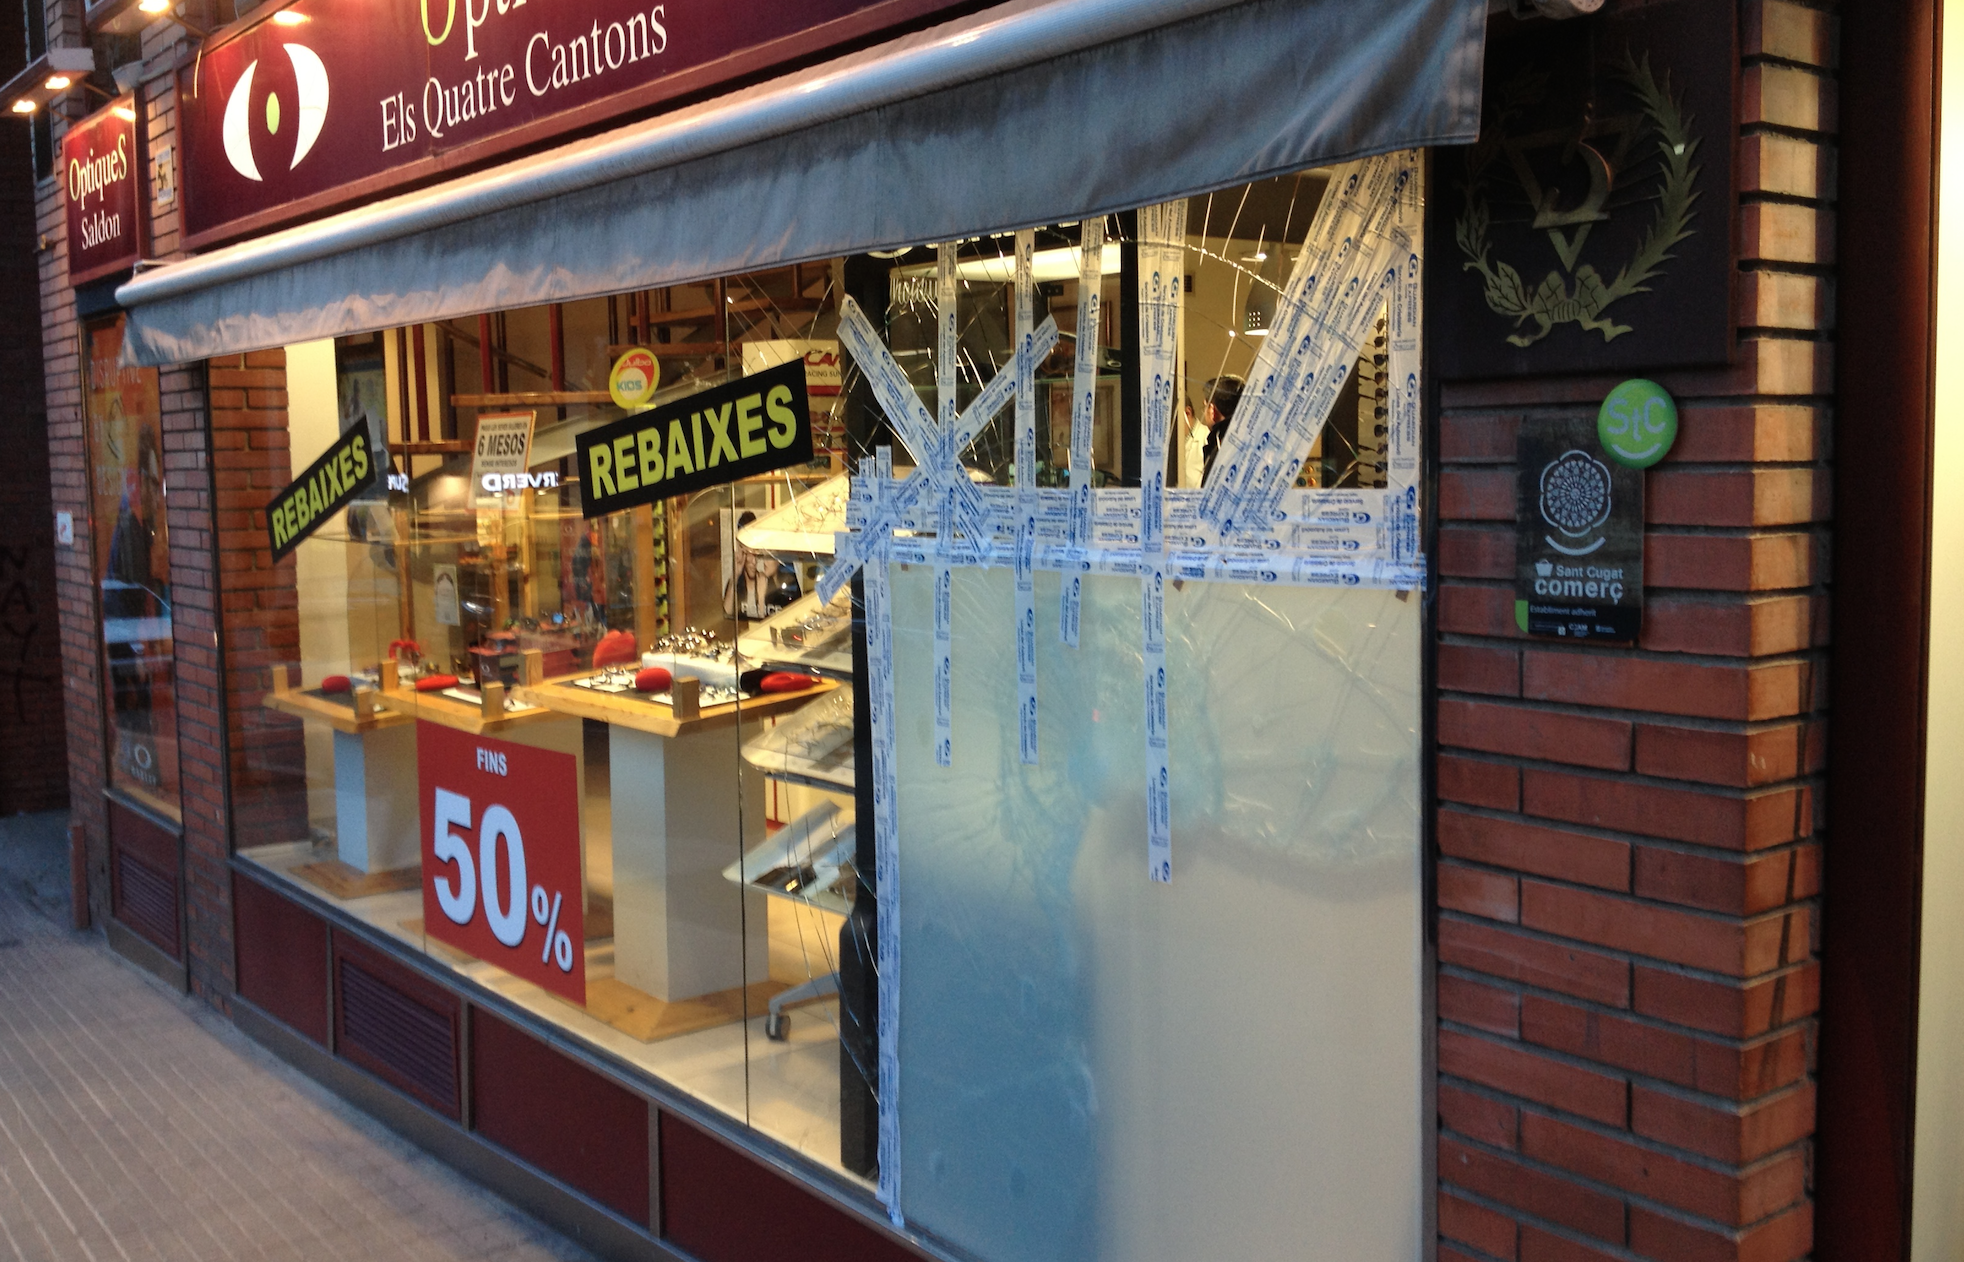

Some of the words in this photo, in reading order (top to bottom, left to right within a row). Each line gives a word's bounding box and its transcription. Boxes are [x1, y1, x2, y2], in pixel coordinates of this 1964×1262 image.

[380, 91, 416, 152] Els
[423, 64, 516, 138] Quatre
[525, 5, 668, 97] Cantons
[81, 210, 121, 250] Saldon
[1606, 396, 1667, 442] StC
[477, 434, 486, 457] 6
[486, 432, 526, 457] MESOS
[588, 384, 797, 499] REBAIXES
[272, 435, 369, 550] REBAIXES
[1534, 578, 1624, 605] comerç
[1556, 565, 1583, 578] Sant
[1586, 566, 1624, 581] Cugat
[476, 747, 508, 777] FINS
[434, 786, 574, 973] 50%
